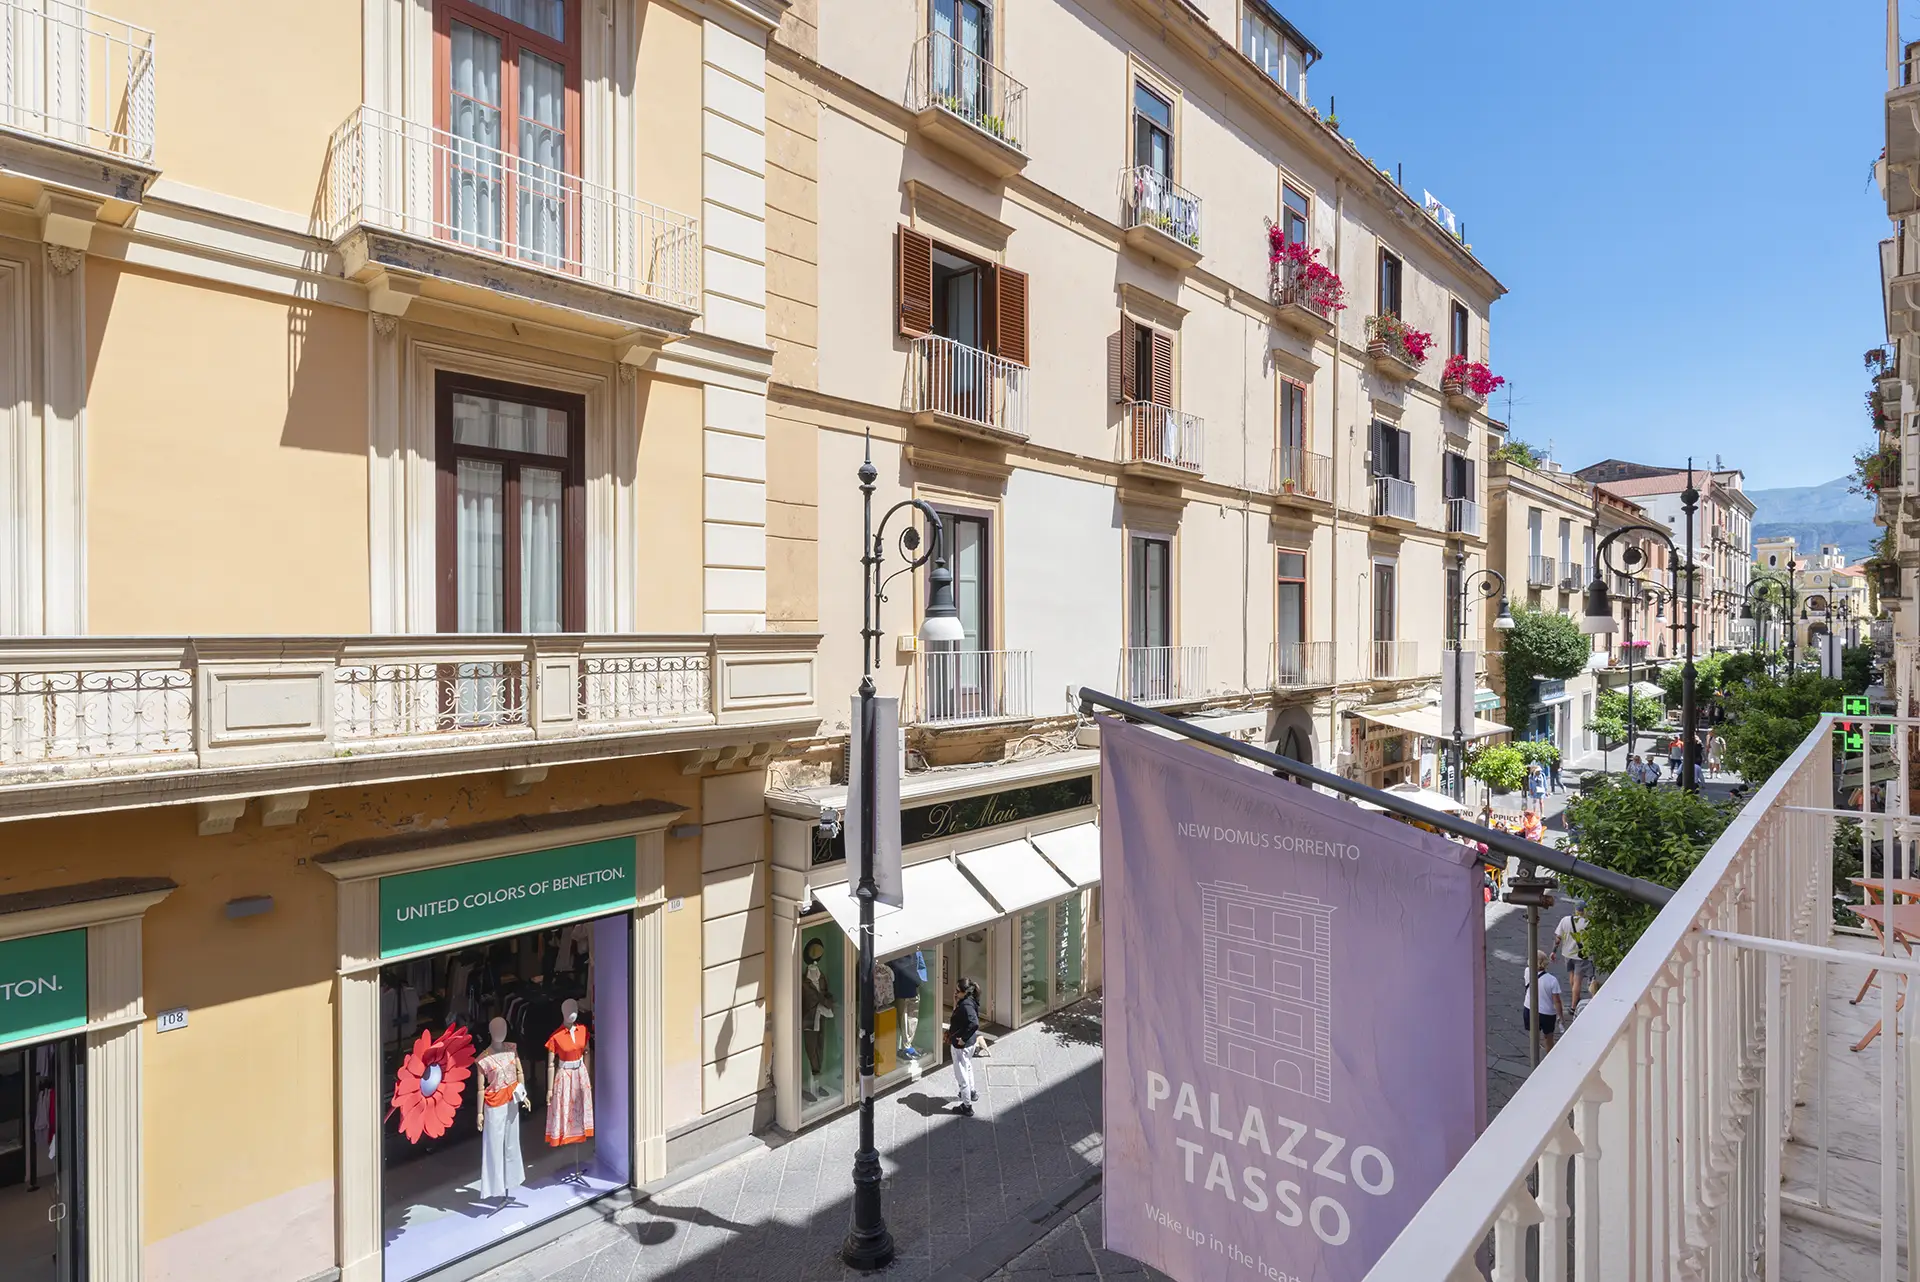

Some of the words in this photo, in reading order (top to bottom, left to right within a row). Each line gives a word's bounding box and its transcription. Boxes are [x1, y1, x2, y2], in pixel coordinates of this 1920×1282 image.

[921, 803, 959, 839] Di
[964, 795, 1020, 829] Maio
[1178, 822, 1210, 840] NEW
[1214, 827, 1269, 849] DOMUS
[1274, 834, 1360, 861] SORRENTO
[396, 898, 459, 922] UNITED
[463, 885, 526, 908] COLORS
[528, 880, 550, 895] OF
[553, 866, 626, 891] BENETTON.
[162, 1012, 184, 1026] 108
[1147, 1070, 1395, 1196] PALAZZO
[1176, 1137, 1350, 1246] TASSO
[1144, 1202, 1182, 1234] Wake
[1186, 1228, 1205, 1247] up
[1210, 1233, 1224, 1254] in
[1228, 1244, 1254, 1268] the
